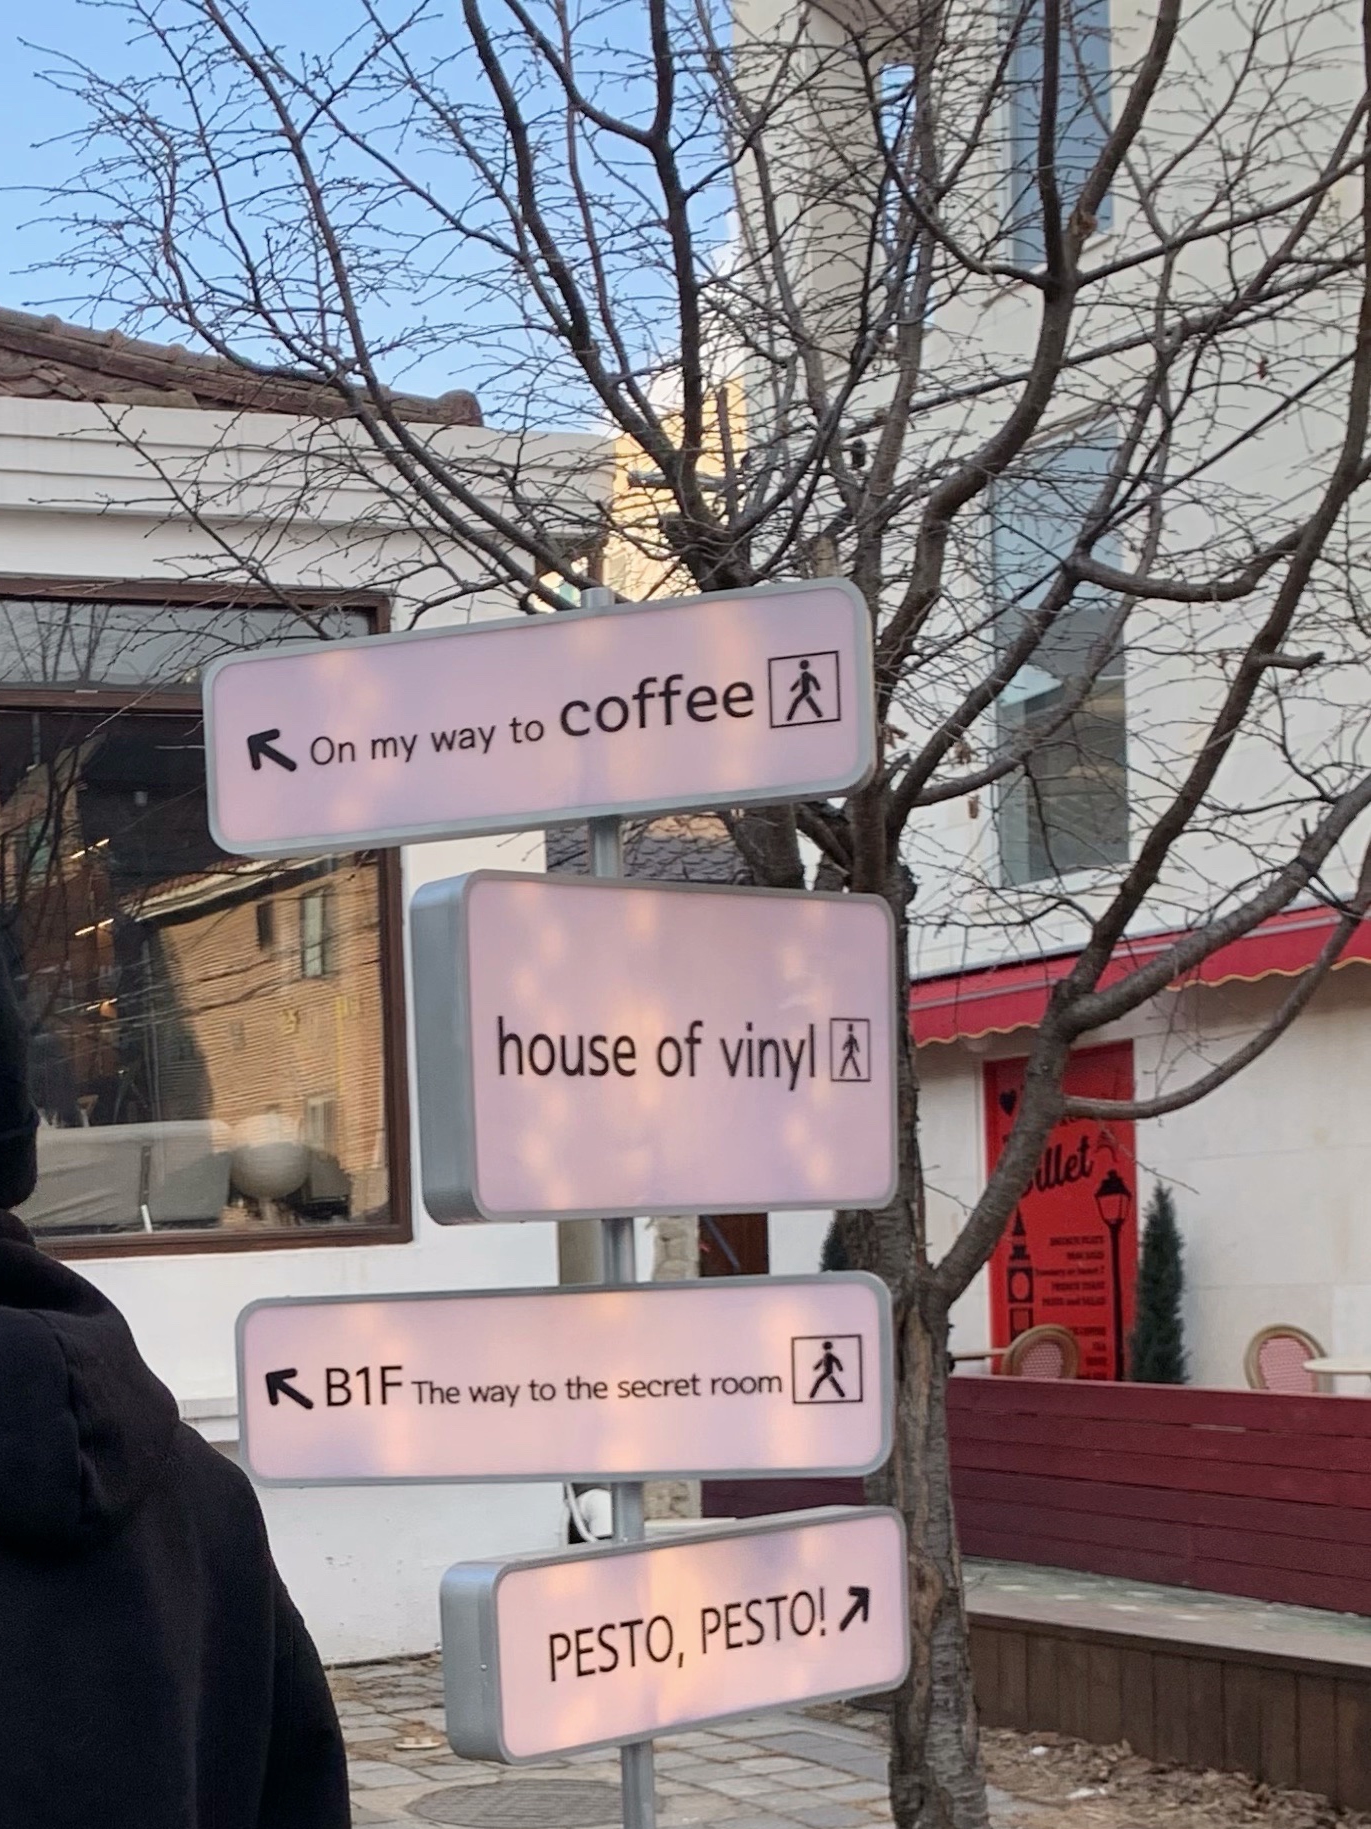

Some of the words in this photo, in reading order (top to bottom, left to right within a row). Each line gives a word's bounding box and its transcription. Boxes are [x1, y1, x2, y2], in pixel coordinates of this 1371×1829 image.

[309, 734, 357, 767] On
[370, 733, 419, 764] my
[429, 724, 497, 755] way
[507, 716, 546, 745] to
[559, 672, 755, 738] coffee
[496, 1014, 637, 1079] house
[655, 1018, 705, 1079] of
[718, 1020, 817, 1093] vinyl
[324, 1364, 404, 1408] B1F
[410, 1379, 462, 1406] The
[467, 1383, 521, 1409] way
[527, 1378, 558, 1403] to
[563, 1374, 609, 1402] the
[616, 1372, 702, 1400] secret
[709, 1374, 784, 1397] room
[548, 1614, 685, 1683] PESTO,
[700, 1586, 827, 1655] PESTO!
